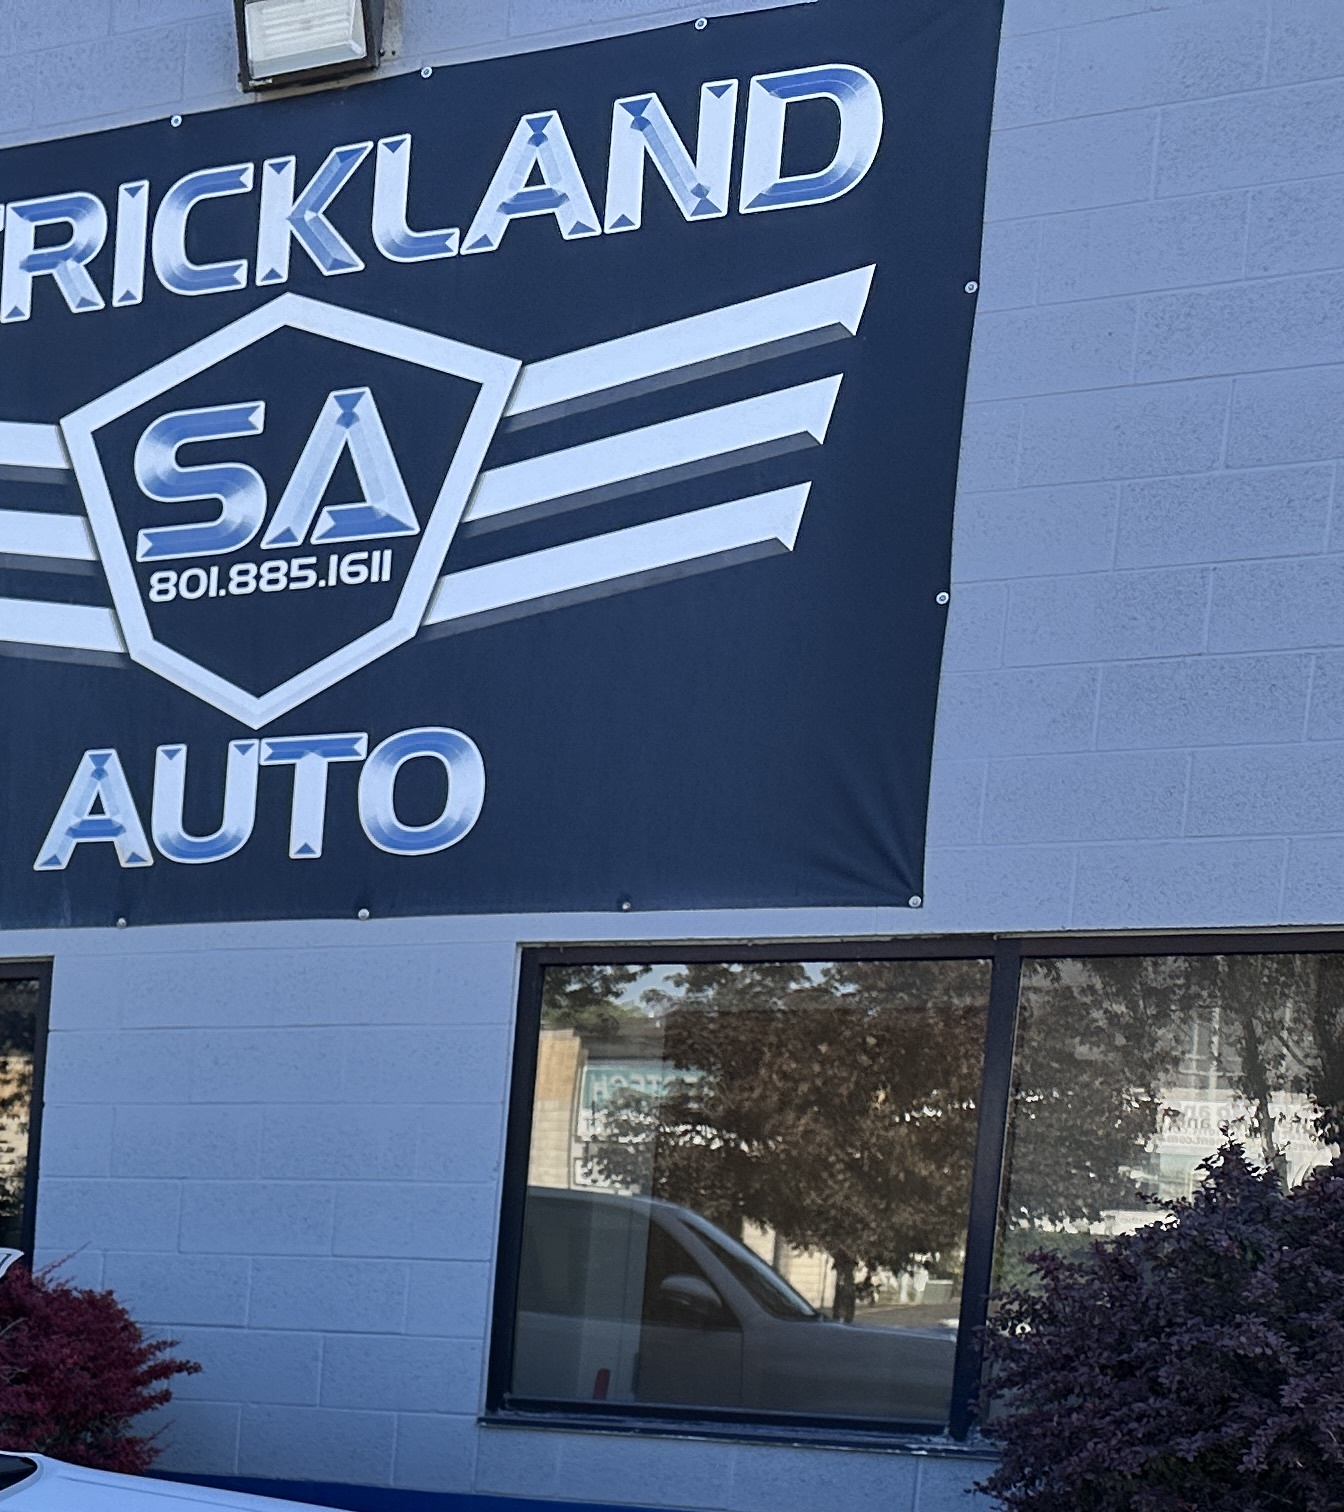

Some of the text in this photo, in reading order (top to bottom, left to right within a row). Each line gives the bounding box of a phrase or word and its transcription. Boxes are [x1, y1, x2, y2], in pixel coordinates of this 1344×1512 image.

[135, 386, 420, 562] SA
[148, 549, 393, 603] 801.885.1611
[32, 726, 487, 873] AUTO
